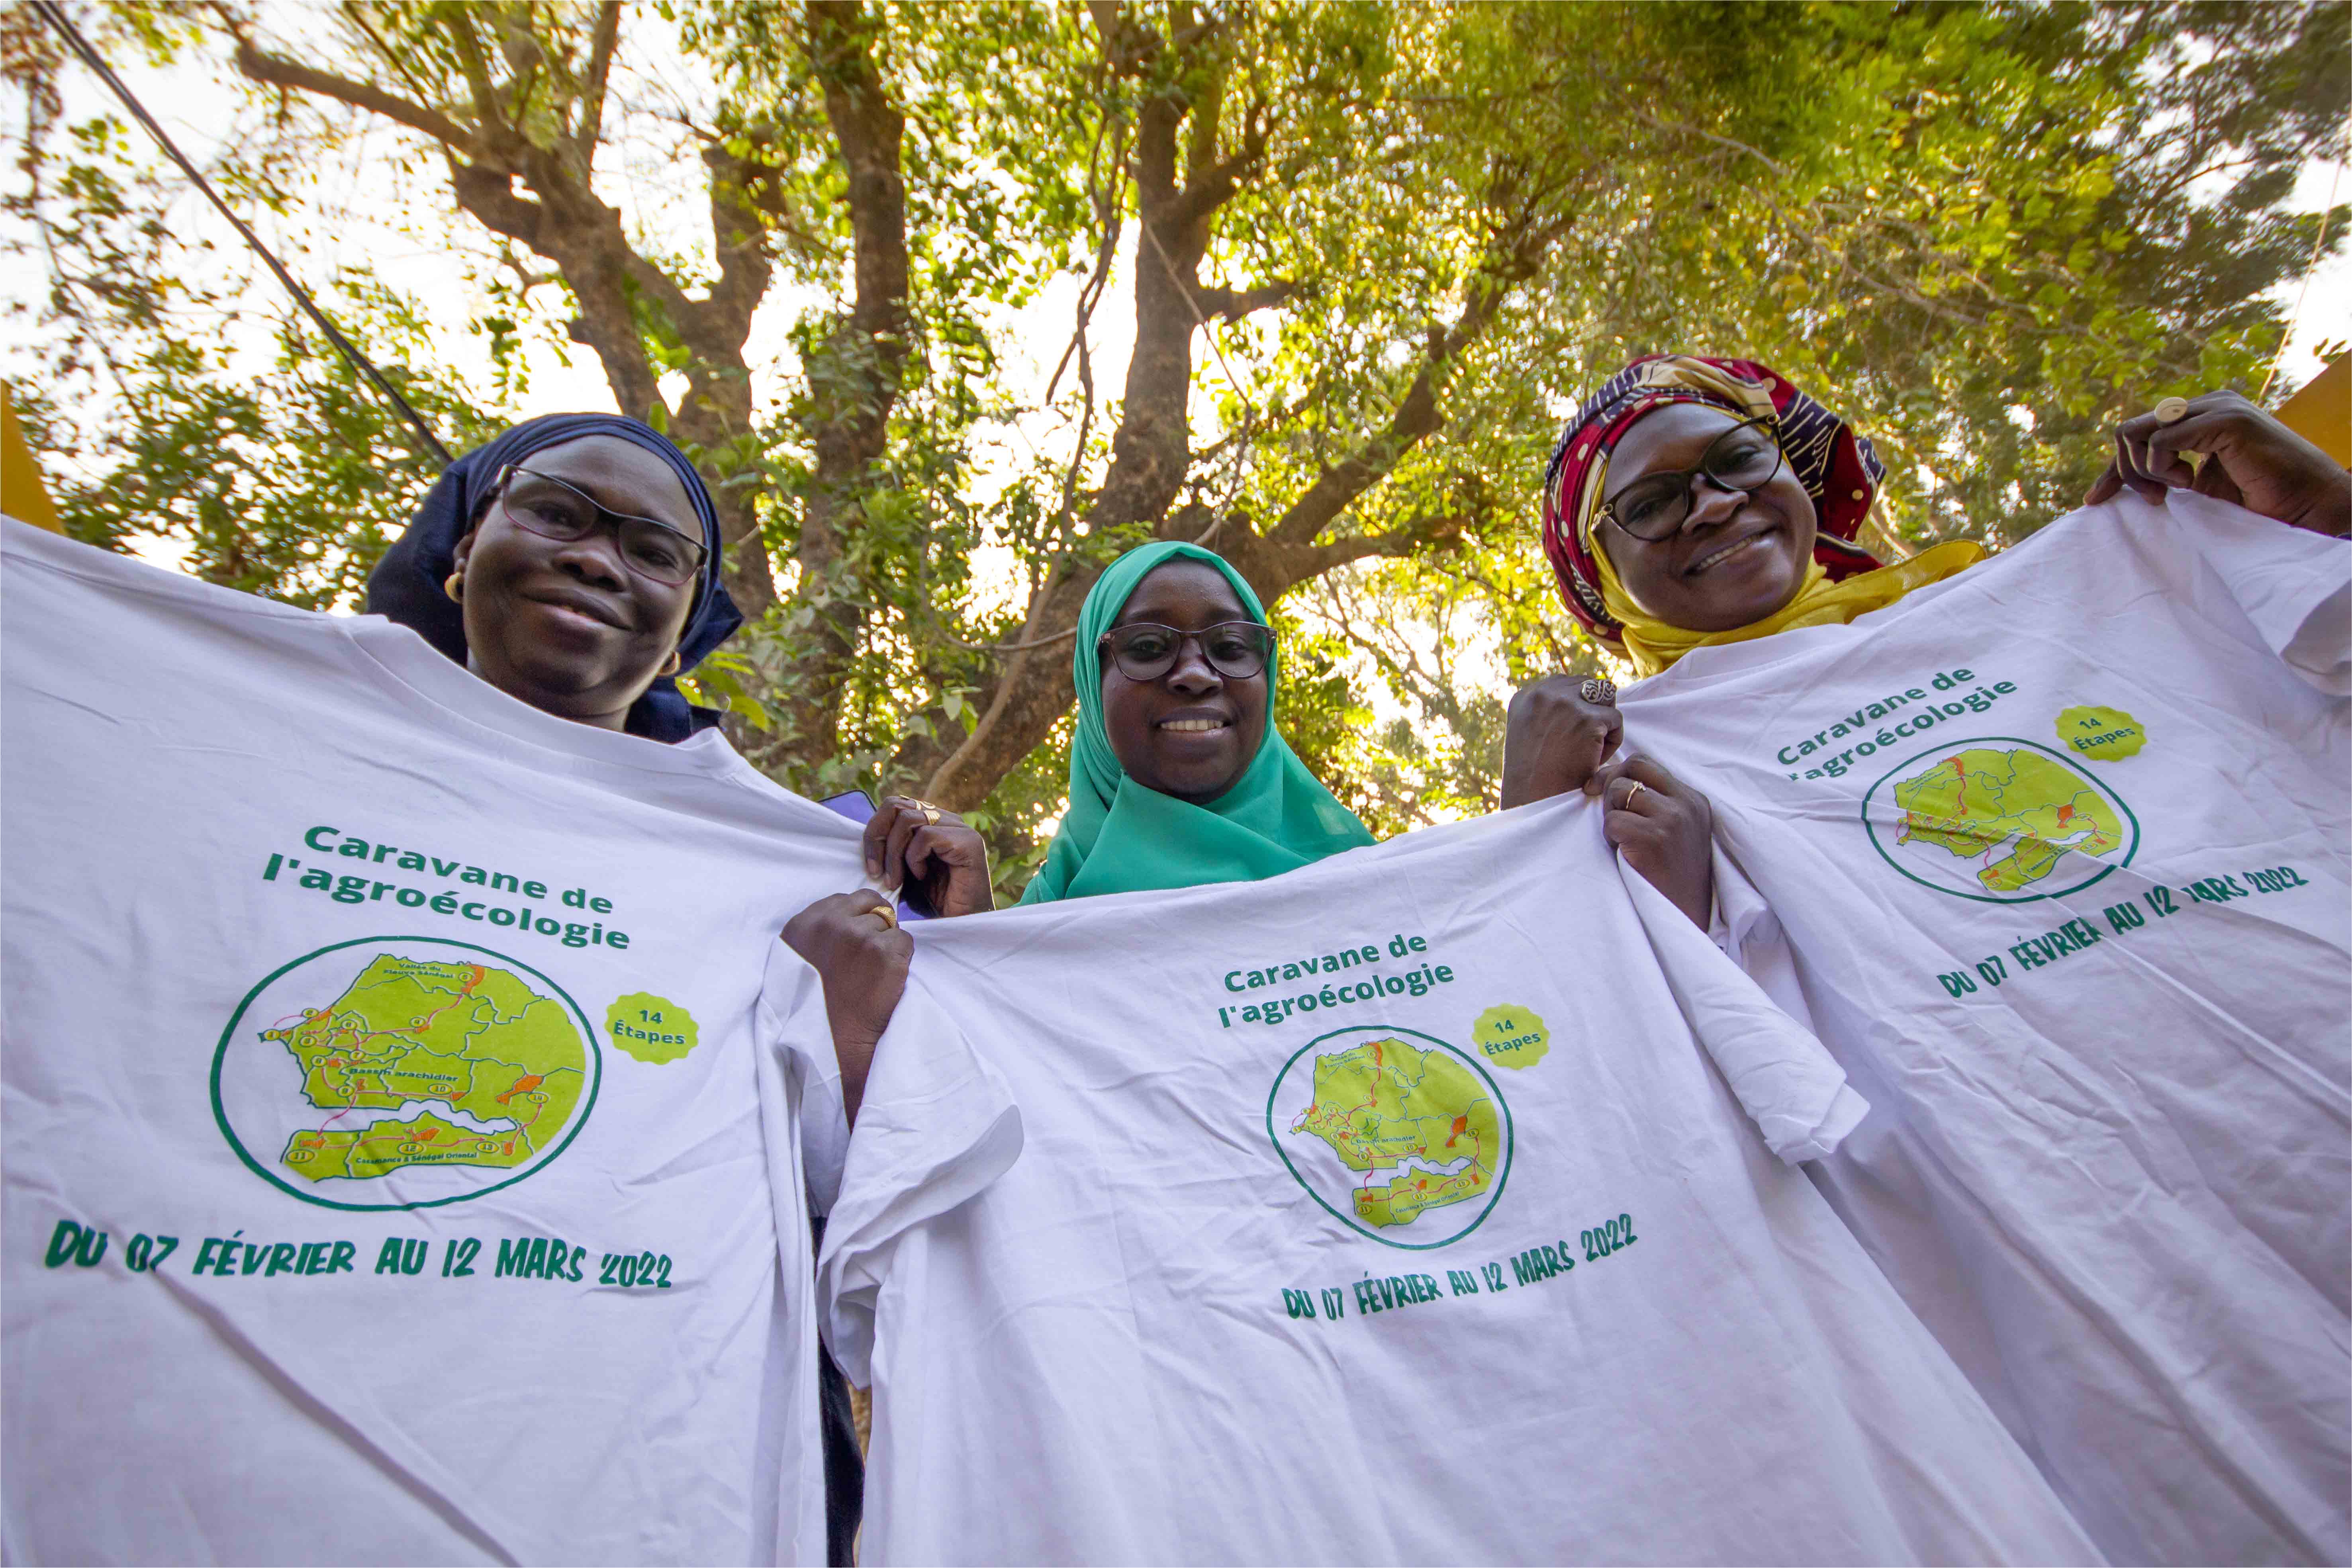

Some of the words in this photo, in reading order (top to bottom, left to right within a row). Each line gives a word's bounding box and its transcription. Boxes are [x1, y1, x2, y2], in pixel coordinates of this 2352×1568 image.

[1777, 687, 1928, 765] Caravane
[1931, 669, 1976, 690] de
[2073, 728, 2135, 750] Étapes
[2079, 718, 2102, 729] 14
[304, 826, 546, 899] Caravane
[562, 888, 613, 914] de
[263, 853, 630, 949] l'agroécologie
[1937, 970, 1978, 999] DU
[1976, 955, 2008, 987] 07
[2103, 901, 2145, 935] AU
[2143, 885, 2180, 918] 12
[2242, 866, 2311, 893] 2022
[1224, 945, 1379, 992] Caravane
[1388, 934, 1427, 957] de
[640, 1009, 662, 1024] 14
[1218, 963, 1454, 1028] l'agroécologie
[613, 1019, 685, 1044] Étapes
[1484, 1033, 1541, 1055] Étapes
[1494, 1019, 1514, 1033] 14
[294, 1152, 306, 1160] 11
[44, 1220, 108, 1269] DU
[125, 1233, 179, 1274] 07
[192, 1229, 356, 1278] FÉVRIER
[374, 1237, 428, 1275] AU
[441, 1237, 481, 1278] 12
[494, 1237, 586, 1282] MARS
[598, 1251, 672, 1288] 2022
[1281, 1288, 1316, 1319] DU
[1322, 1288, 1344, 1321] 07
[1352, 1271, 1443, 1315] FÉVRIER
[1446, 1270, 1479, 1297] AU
[1481, 1262, 1508, 1292] 12
[1510, 1240, 1575, 1287] MARS
[1581, 1213, 1638, 1263] 2022
